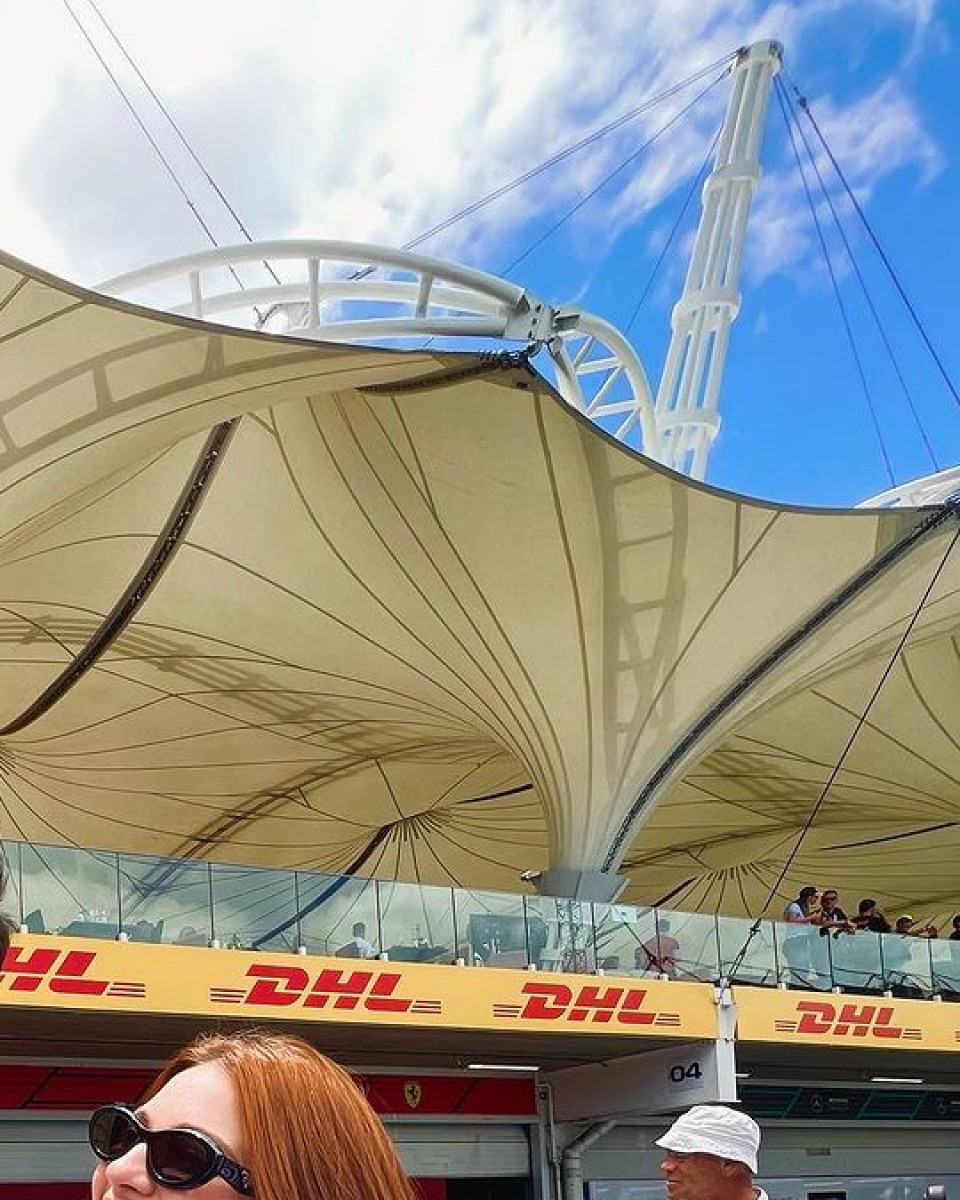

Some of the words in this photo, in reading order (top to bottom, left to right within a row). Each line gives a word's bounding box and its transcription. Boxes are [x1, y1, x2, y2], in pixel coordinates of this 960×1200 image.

[243, 964, 413, 1013] DHL
[520, 982, 656, 1025] DHL
[797, 1001, 903, 1039] DHL
[671, 1062, 702, 1082] 04
